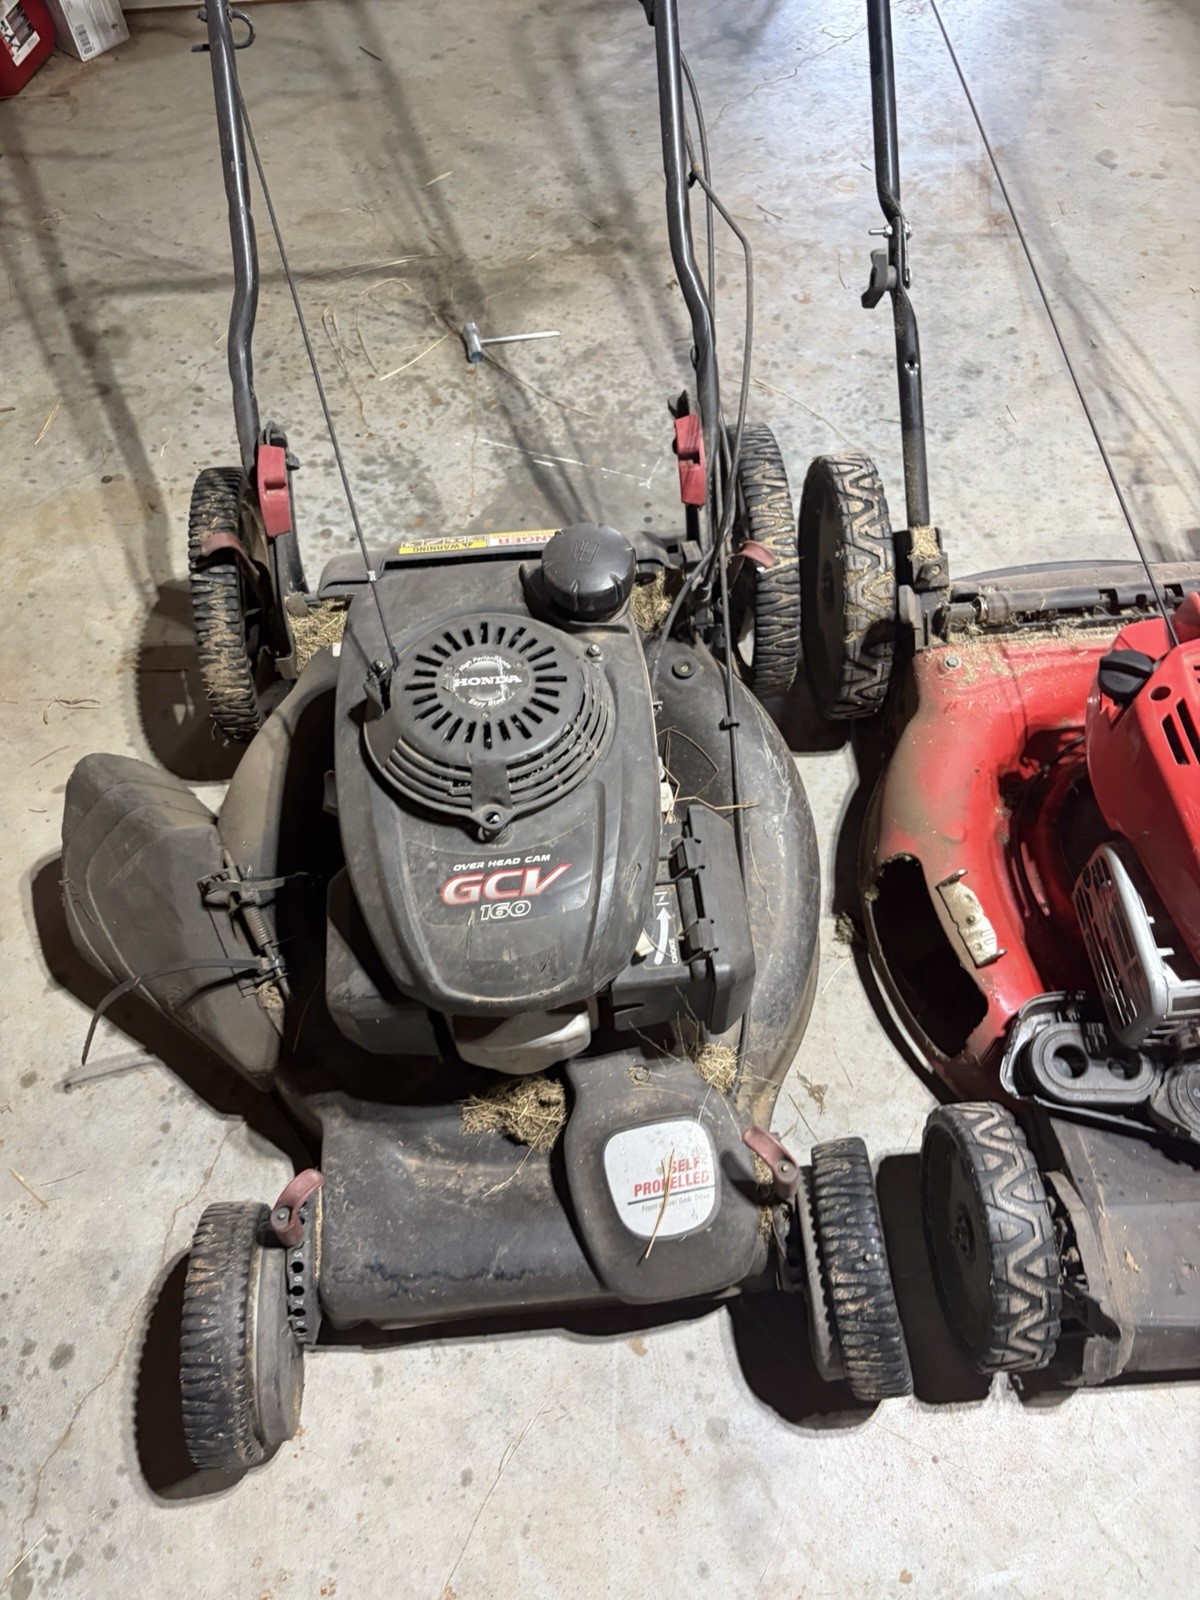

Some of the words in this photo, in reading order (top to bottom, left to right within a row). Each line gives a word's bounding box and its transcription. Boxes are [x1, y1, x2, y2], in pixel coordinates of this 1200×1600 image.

[498, 535, 551, 544] NGER
[453, 675, 522, 686] HONDA
[453, 861, 484, 872] OVER
[488, 858, 520, 868] HEAD
[525, 854, 551, 864] CAM
[440, 863, 572, 906] GCV
[480, 900, 532, 921] 160
[669, 938, 678, 964] CHOKE
[671, 1157, 701, 1174] SELF
[642, 1203, 658, 1213] Front
